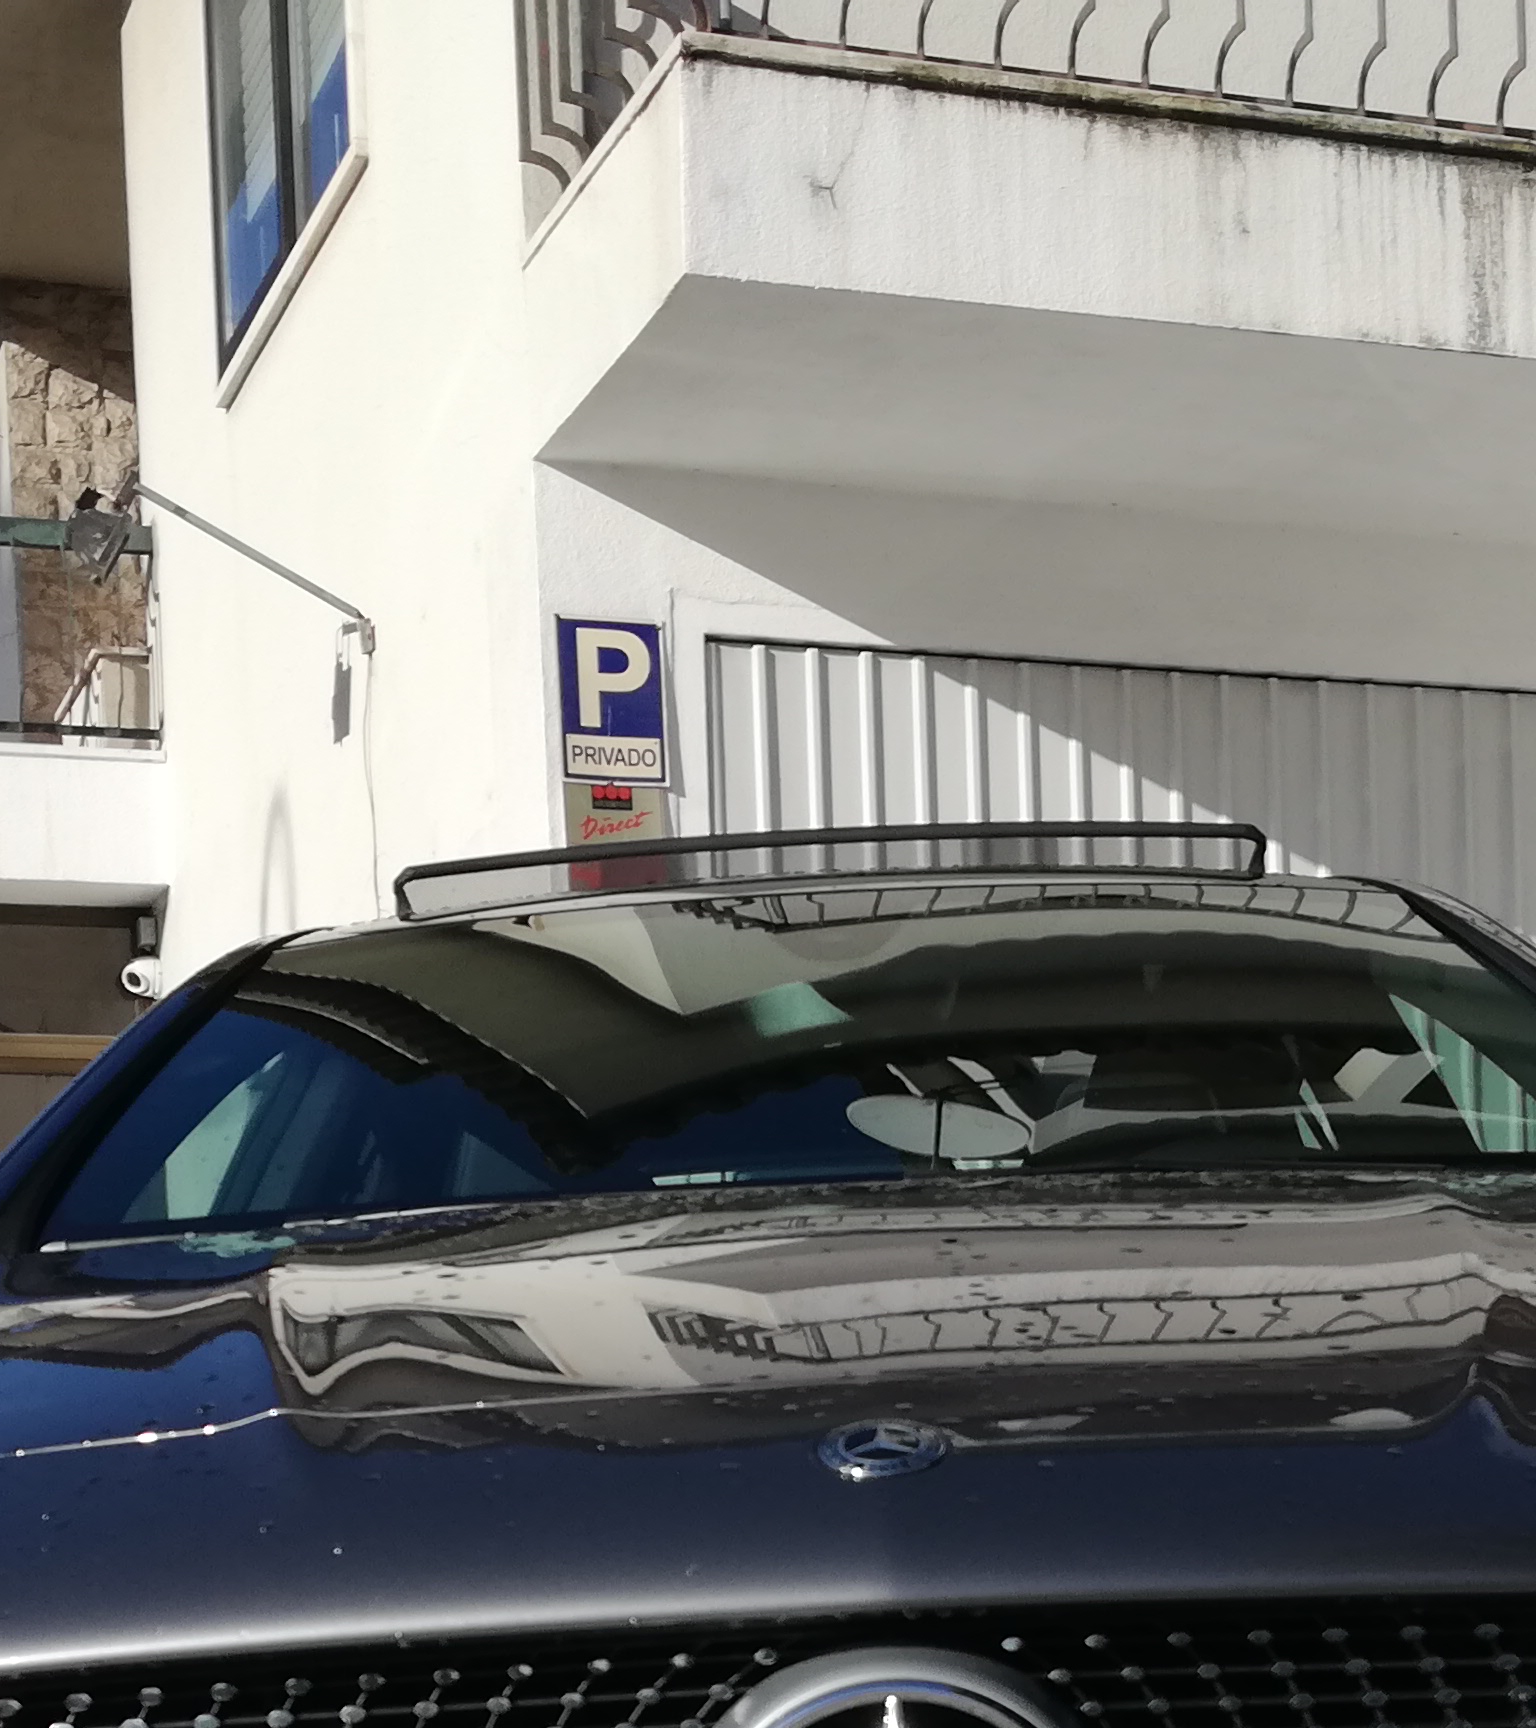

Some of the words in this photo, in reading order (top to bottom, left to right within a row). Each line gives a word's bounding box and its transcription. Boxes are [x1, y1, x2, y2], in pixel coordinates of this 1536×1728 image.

[575, 626, 651, 728] P
[571, 744, 657, 768] PRIVADO
[579, 811, 654, 841] Direct
